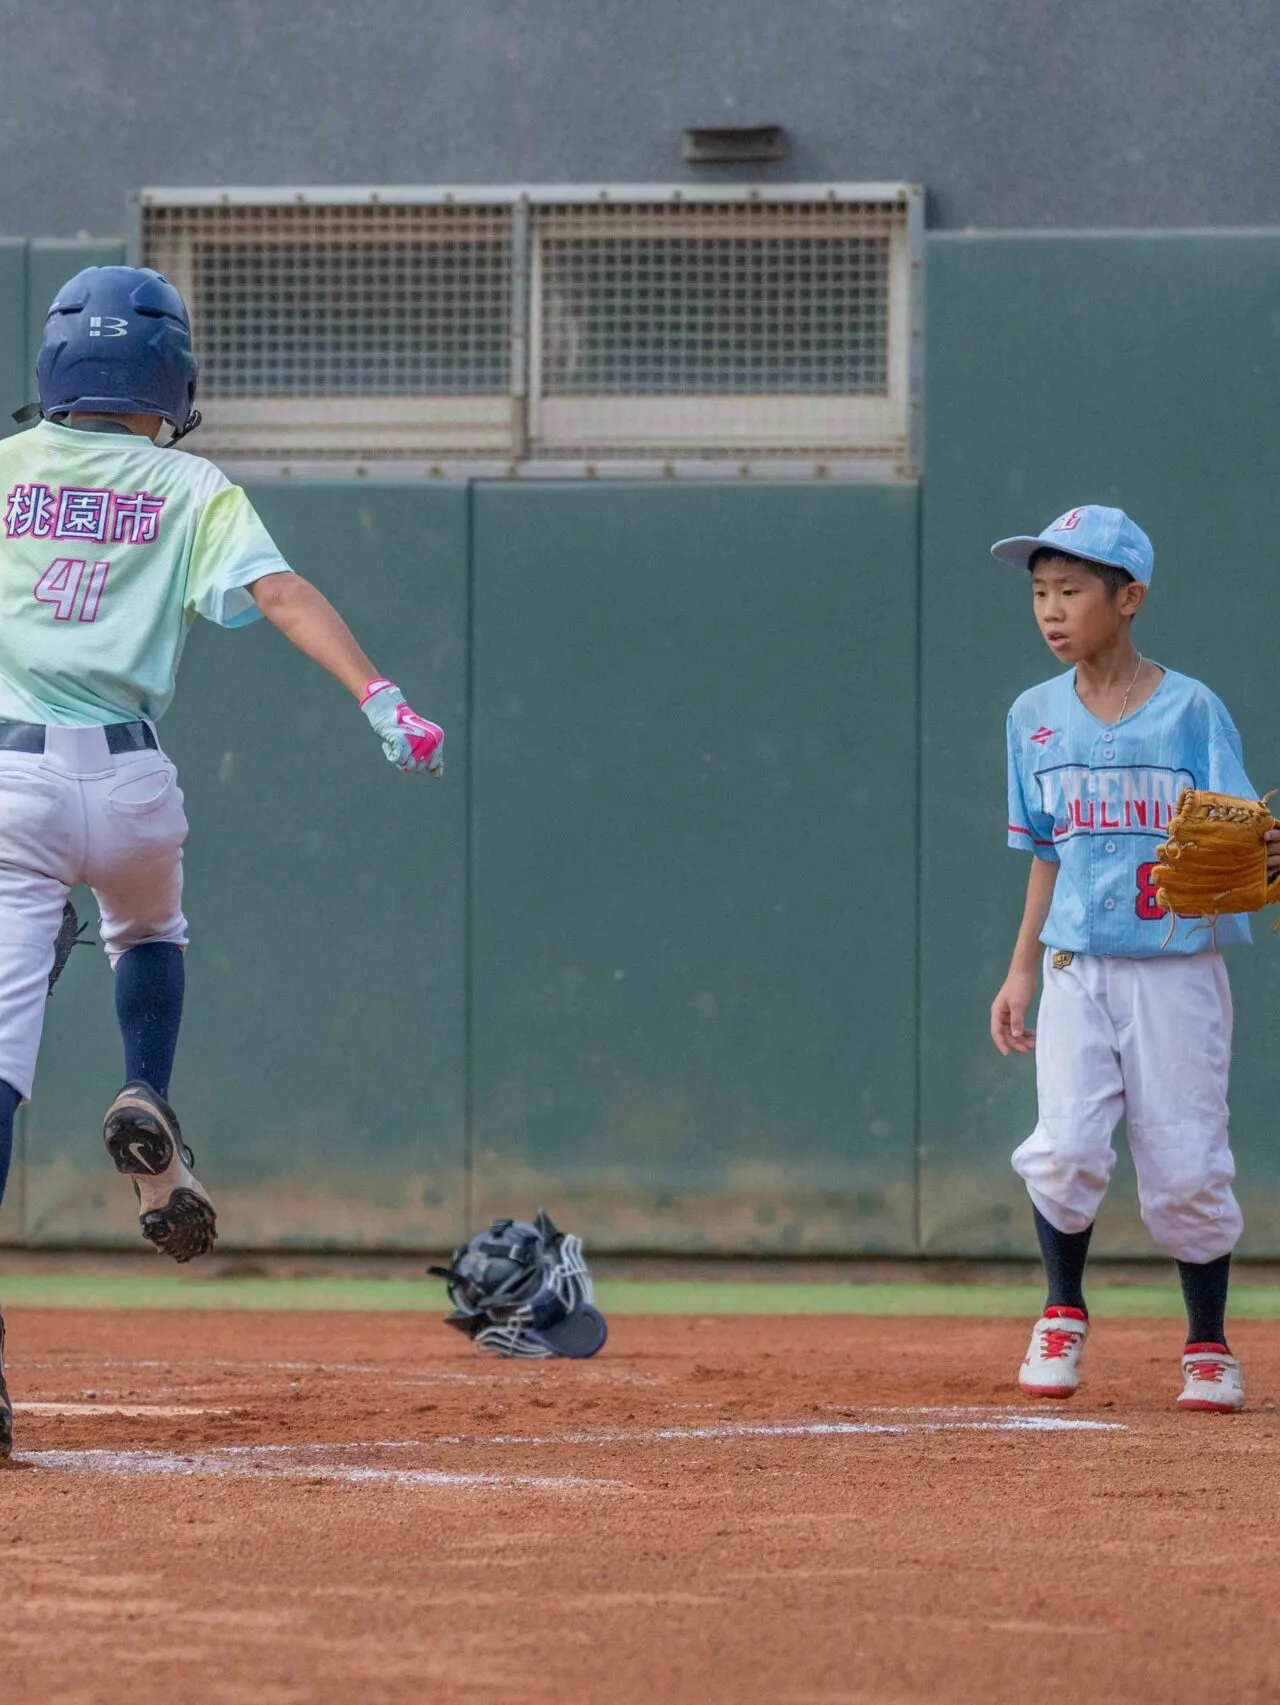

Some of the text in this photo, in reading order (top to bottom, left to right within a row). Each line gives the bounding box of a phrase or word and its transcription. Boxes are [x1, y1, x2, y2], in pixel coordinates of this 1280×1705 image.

[4, 483, 167, 545] 桃園市
[33, 558, 111, 623] 41
